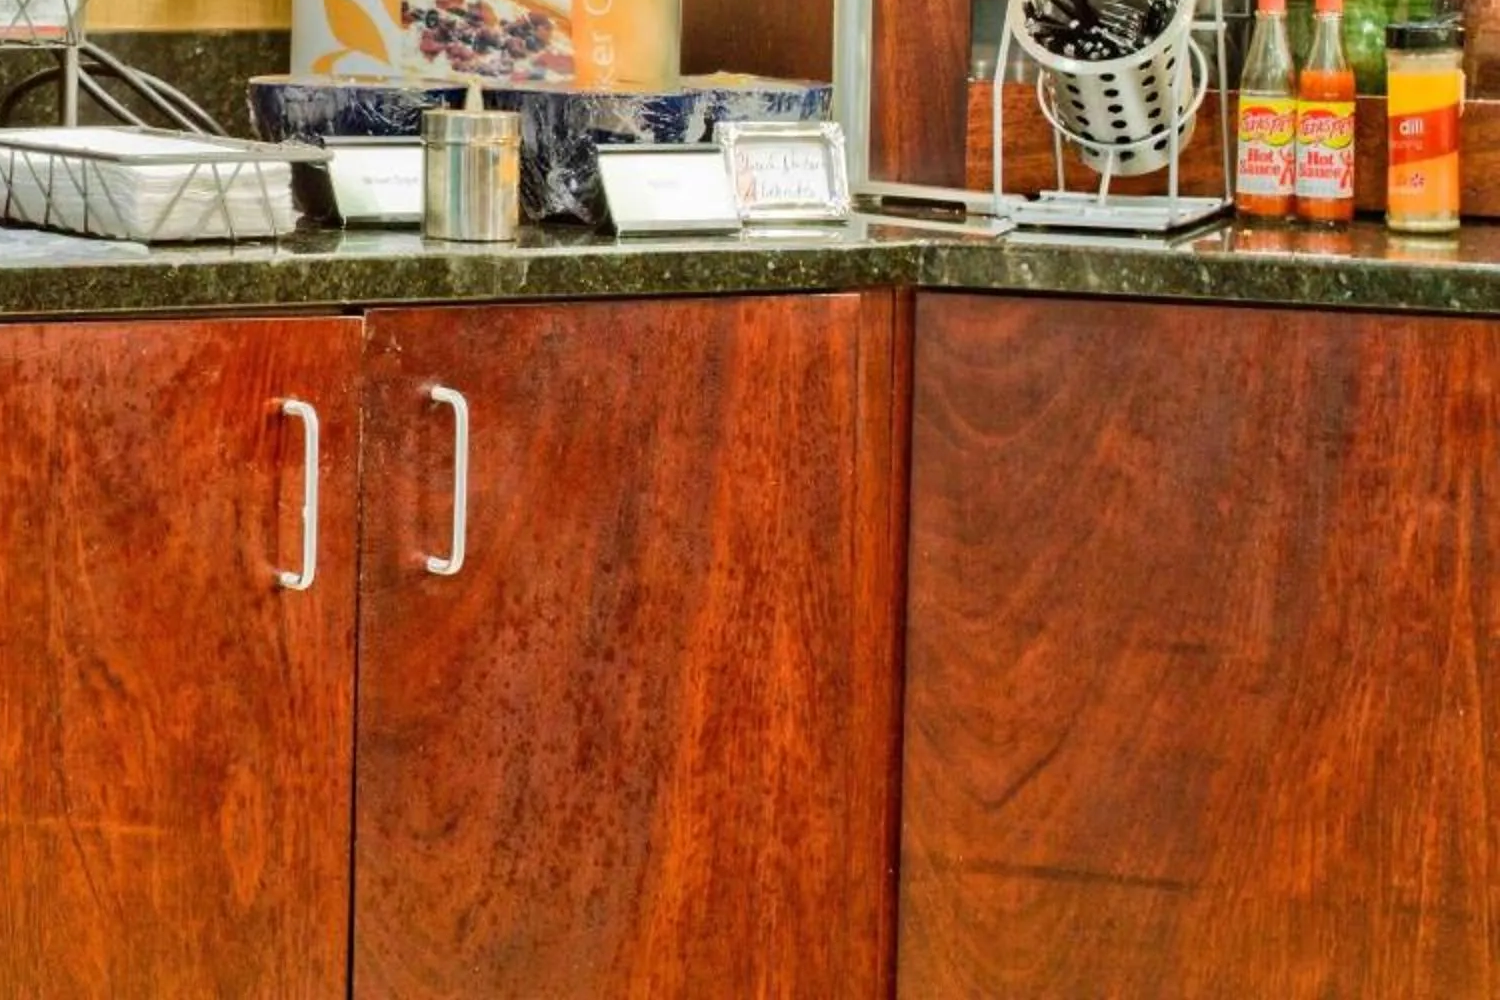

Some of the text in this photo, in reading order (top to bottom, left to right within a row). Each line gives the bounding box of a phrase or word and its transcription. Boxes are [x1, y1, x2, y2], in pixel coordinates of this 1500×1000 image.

[1248, 148, 1274, 162] Hot
[1307, 151, 1334, 165] Hot
[1240, 160, 1281, 177] Sauce
[1300, 163, 1342, 179] Sauce
